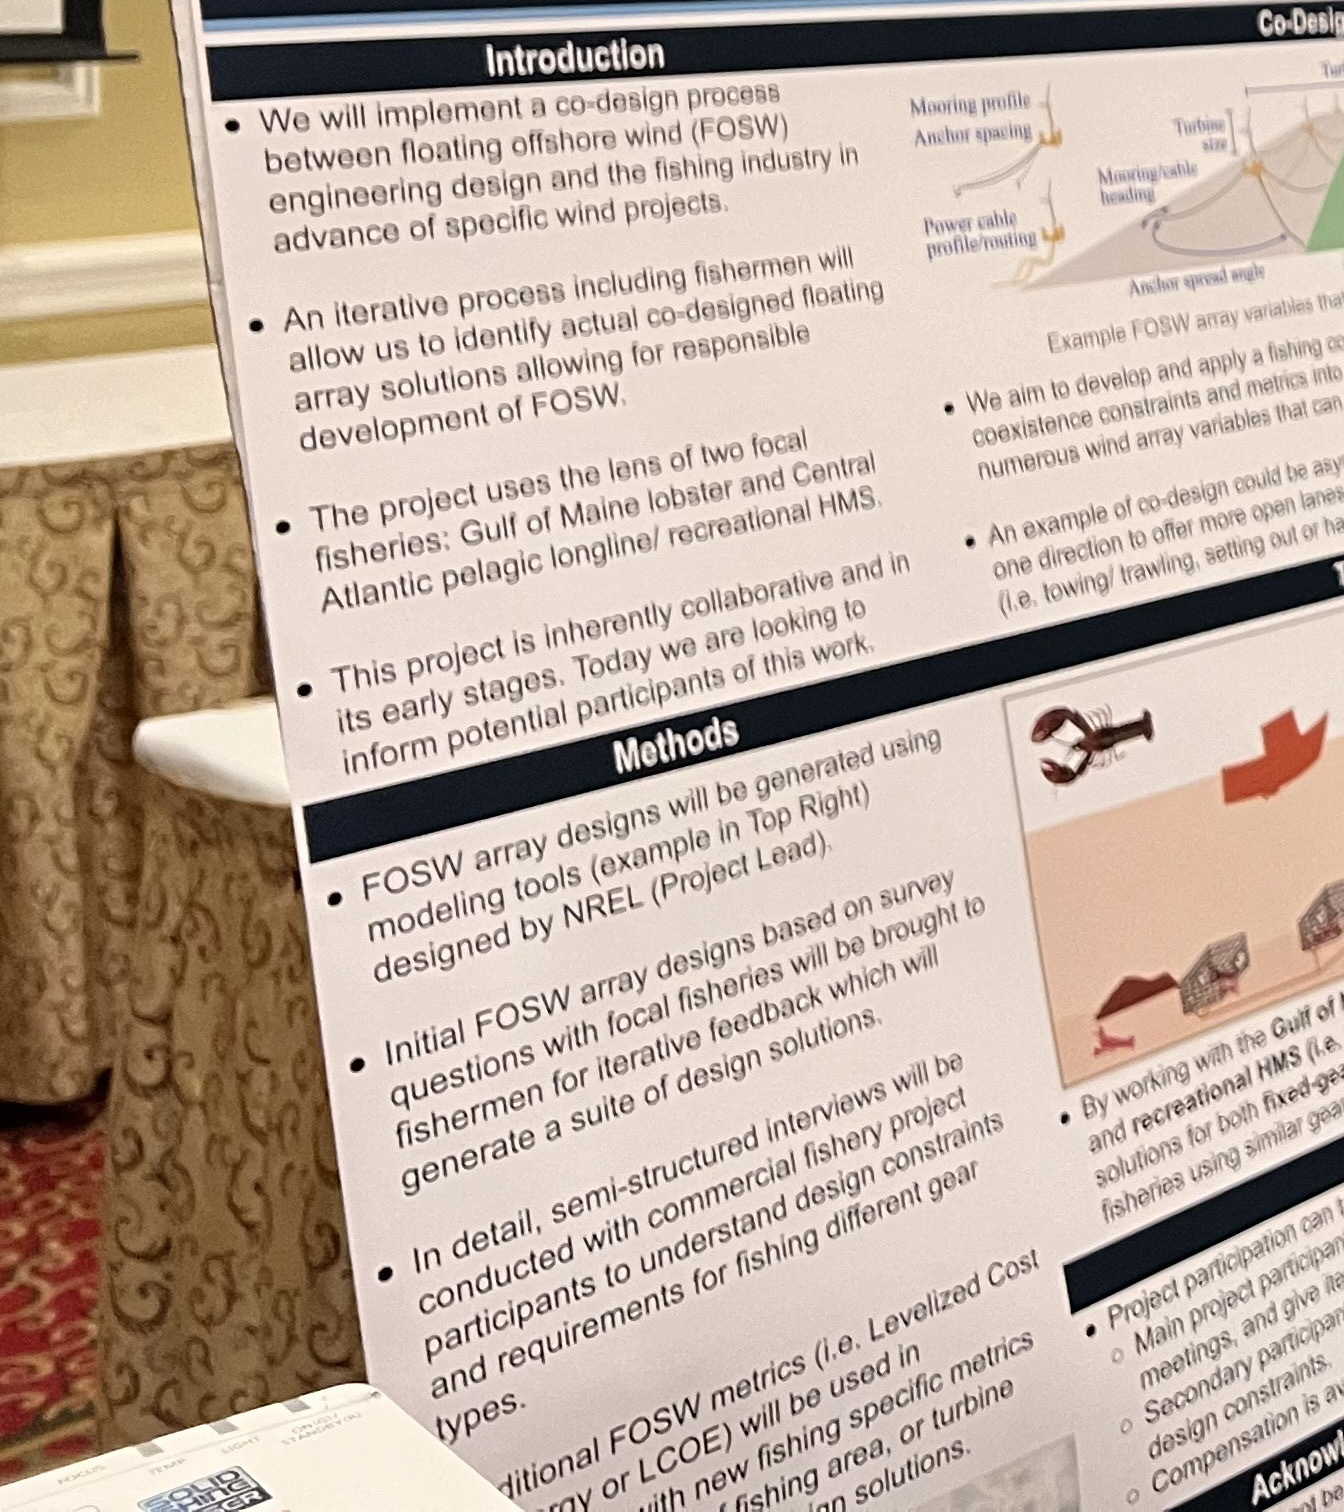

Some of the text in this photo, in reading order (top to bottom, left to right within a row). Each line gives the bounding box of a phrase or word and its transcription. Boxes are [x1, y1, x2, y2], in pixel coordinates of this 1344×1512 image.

[486, 38, 665, 77] Introduction
[259, 84, 780, 134] We will implement a co-design process
[910, 91, 1030, 117] Mooring profile
[265, 113, 787, 174] between floating offshore wind (FOSW)
[915, 123, 1032, 147] Anchor spacing
[1174, 114, 1227, 136] Turbine
[1202, 138, 1227, 153] size
[269, 142, 858, 217] engineering design and the fishing industry in
[1098, 161, 1198, 186] Mooring/cable
[1100, 186, 1156, 206] heading
[274, 190, 728, 253] advance of specific wind projects.
[923, 209, 1017, 239] Power cable
[926, 232, 1037, 260] profile/routing
[1129, 274, 1180, 298] Anchor
[1230, 261, 1265, 285] angle
[966, 389, 1002, 415] We
[1008, 385, 1046, 408] aim
[1051, 380, 1070, 400] to
[1076, 366, 1151, 396] develop
[1157, 356, 1192, 382] and
[1198, 348, 1246, 378] apply
[1252, 349, 1264, 366] a
[1268, 338, 1323, 363] fishing
[613, 721, 739, 774] Methods
[362, 729, 941, 901] FOSW array designs will be generated using
[368, 781, 869, 943] modeling tools (example in Top Right)
[374, 829, 832, 983] designed by NREL (Project Lead).
[419, 1086, 967, 1315] conducted with commercial fishery project
[425, 1113, 1004, 1364] participants to understand design constraints
[1108, 1279, 1180, 1331] Project
[1184, 1224, 1297, 1299] participation
[1300, 1207, 1334, 1235] can
[221, 1436, 261, 1455] LIGHT
[58, 1465, 106, 1485] FOCUS
[148, 1458, 186, 1475] TEMP
[145, 1470, 241, 1508] SOLID
